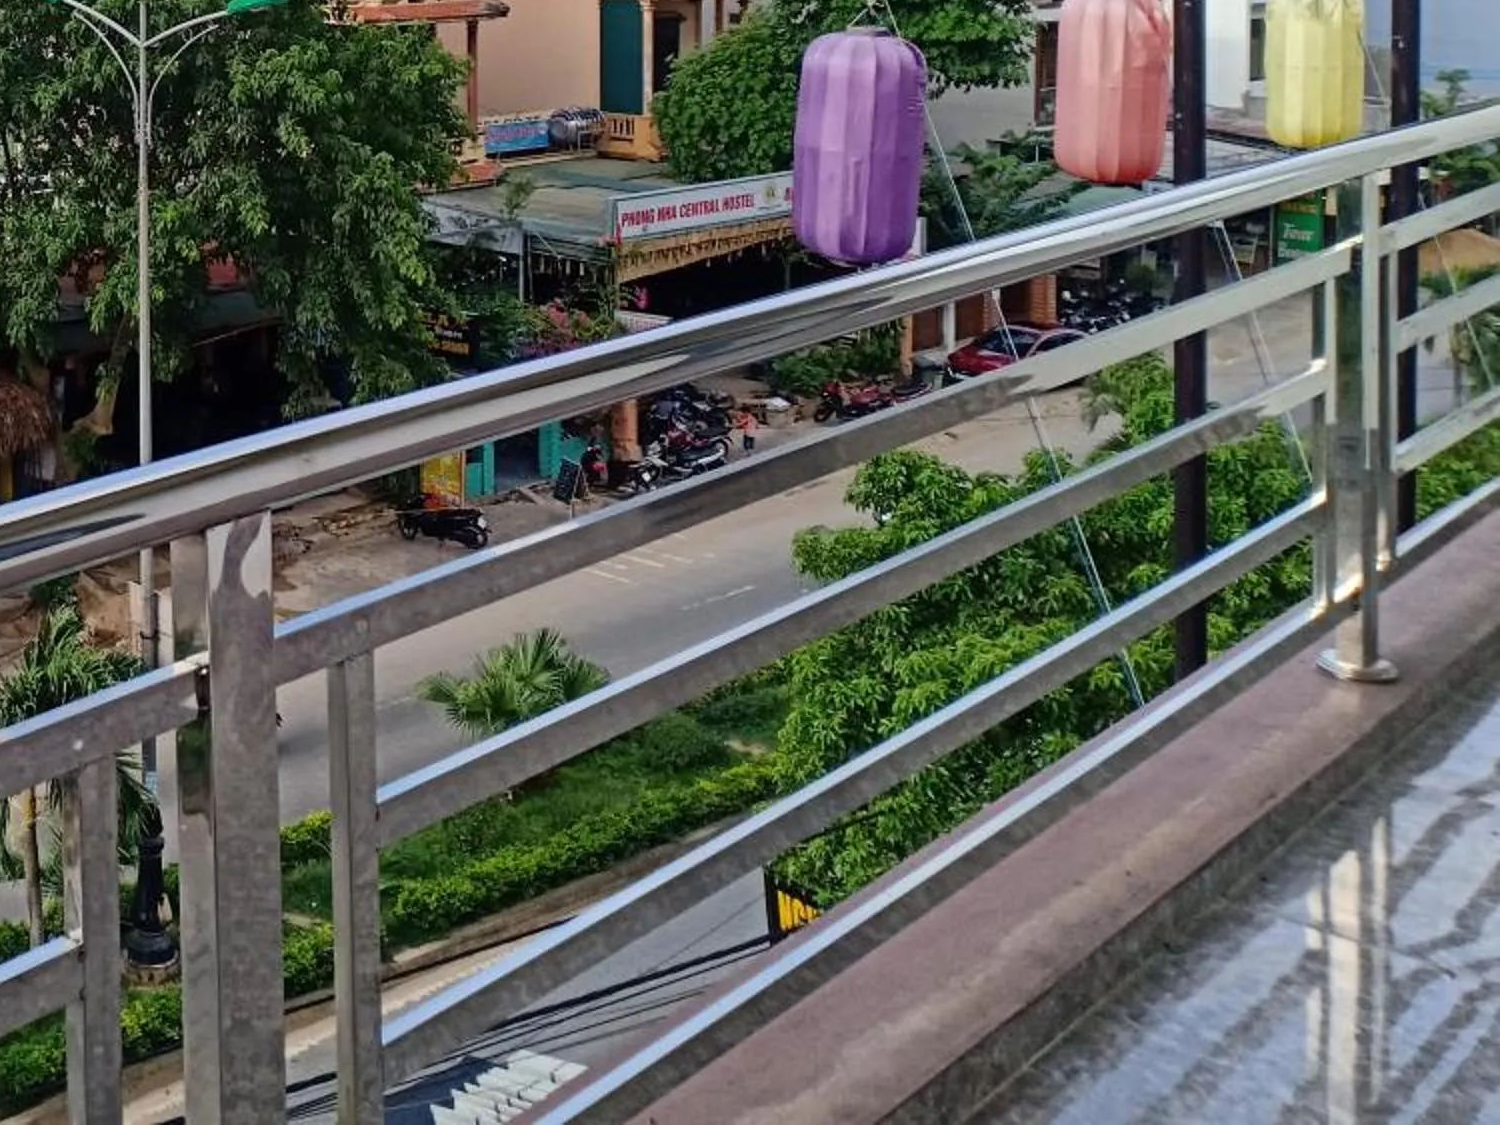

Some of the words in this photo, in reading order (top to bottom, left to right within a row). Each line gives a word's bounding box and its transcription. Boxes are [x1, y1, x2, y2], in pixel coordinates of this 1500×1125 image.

[621, 208, 655, 227] PHONG
[657, 204, 677, 221] NHA
[679, 198, 719, 218] CENTRAL
[722, 193, 755, 211] HOSTEL
